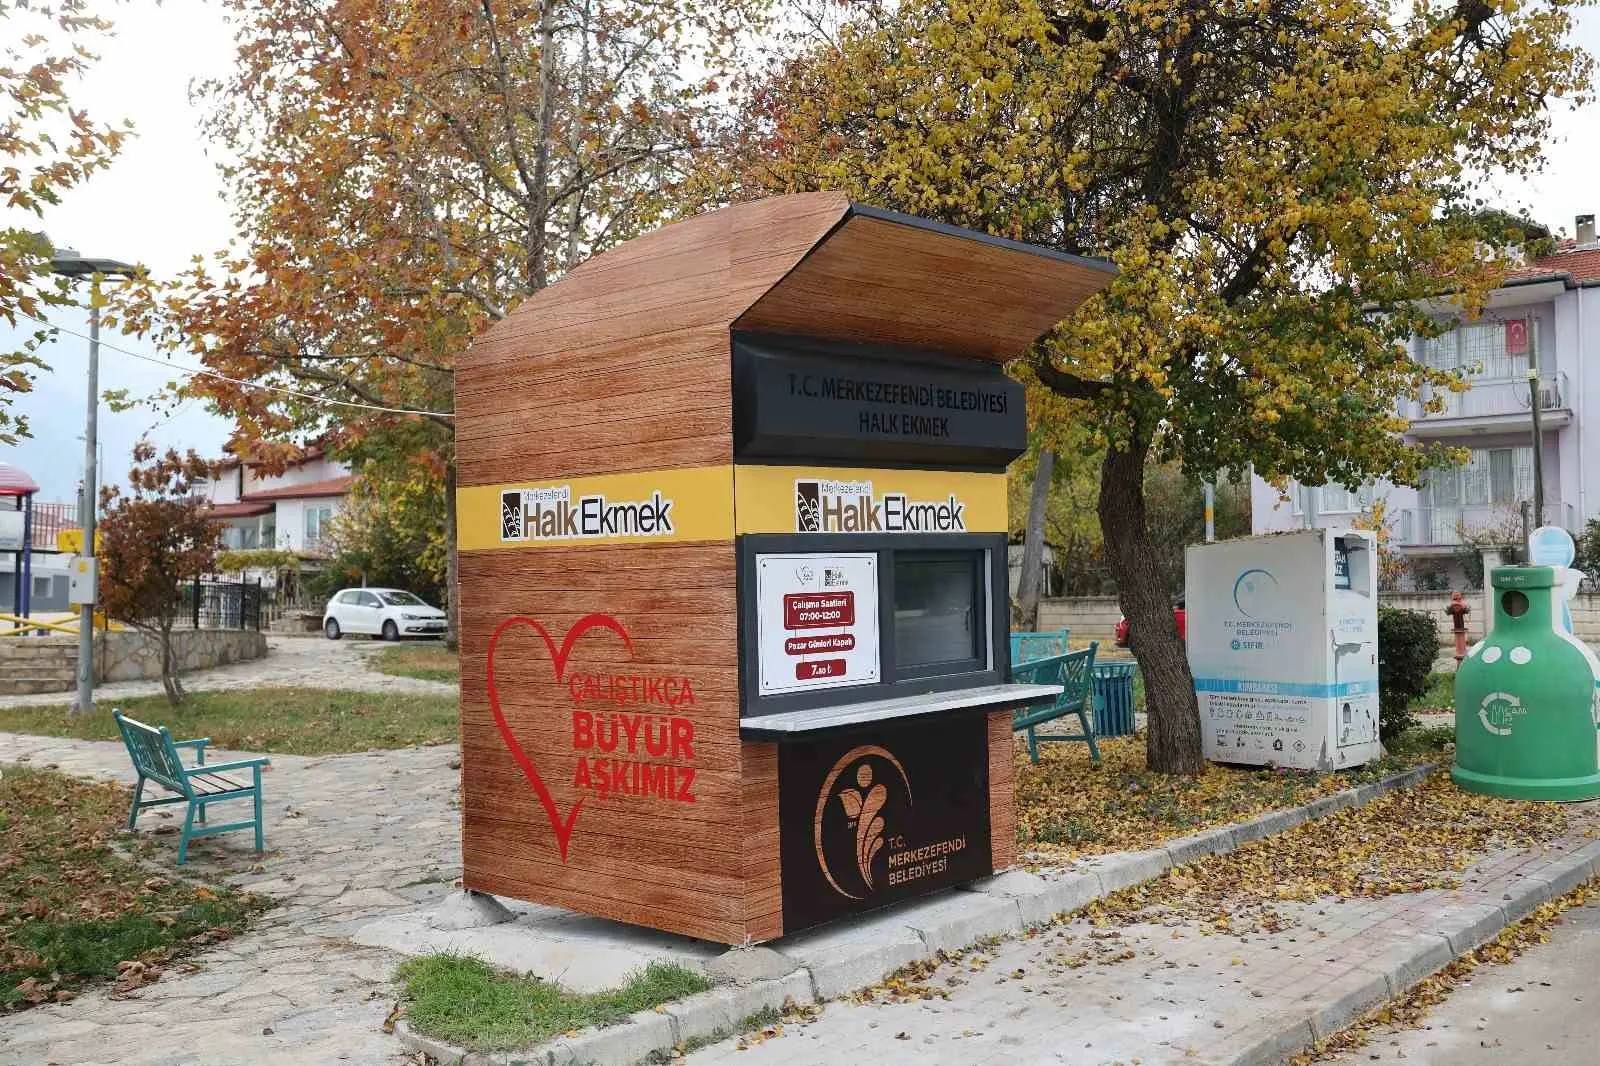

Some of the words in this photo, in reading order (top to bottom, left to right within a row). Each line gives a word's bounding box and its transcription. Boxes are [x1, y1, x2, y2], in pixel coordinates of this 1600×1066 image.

[937, 386, 1008, 415] BELEDİYESİ
[859, 410, 899, 434] HALK
[901, 414, 949, 438] EKMEK
[793, 600, 820, 611] Çalışma
[788, 642, 807, 651] Pazar
[569, 672, 696, 711] ÇALIŞTIKÇA
[572, 710, 696, 761] BÜYÜR
[574, 756, 697, 804] AŞKIMIZ
[888, 831, 967, 869] MERKEZEFENDİ
[888, 857, 949, 887] BELEDİYESİ
